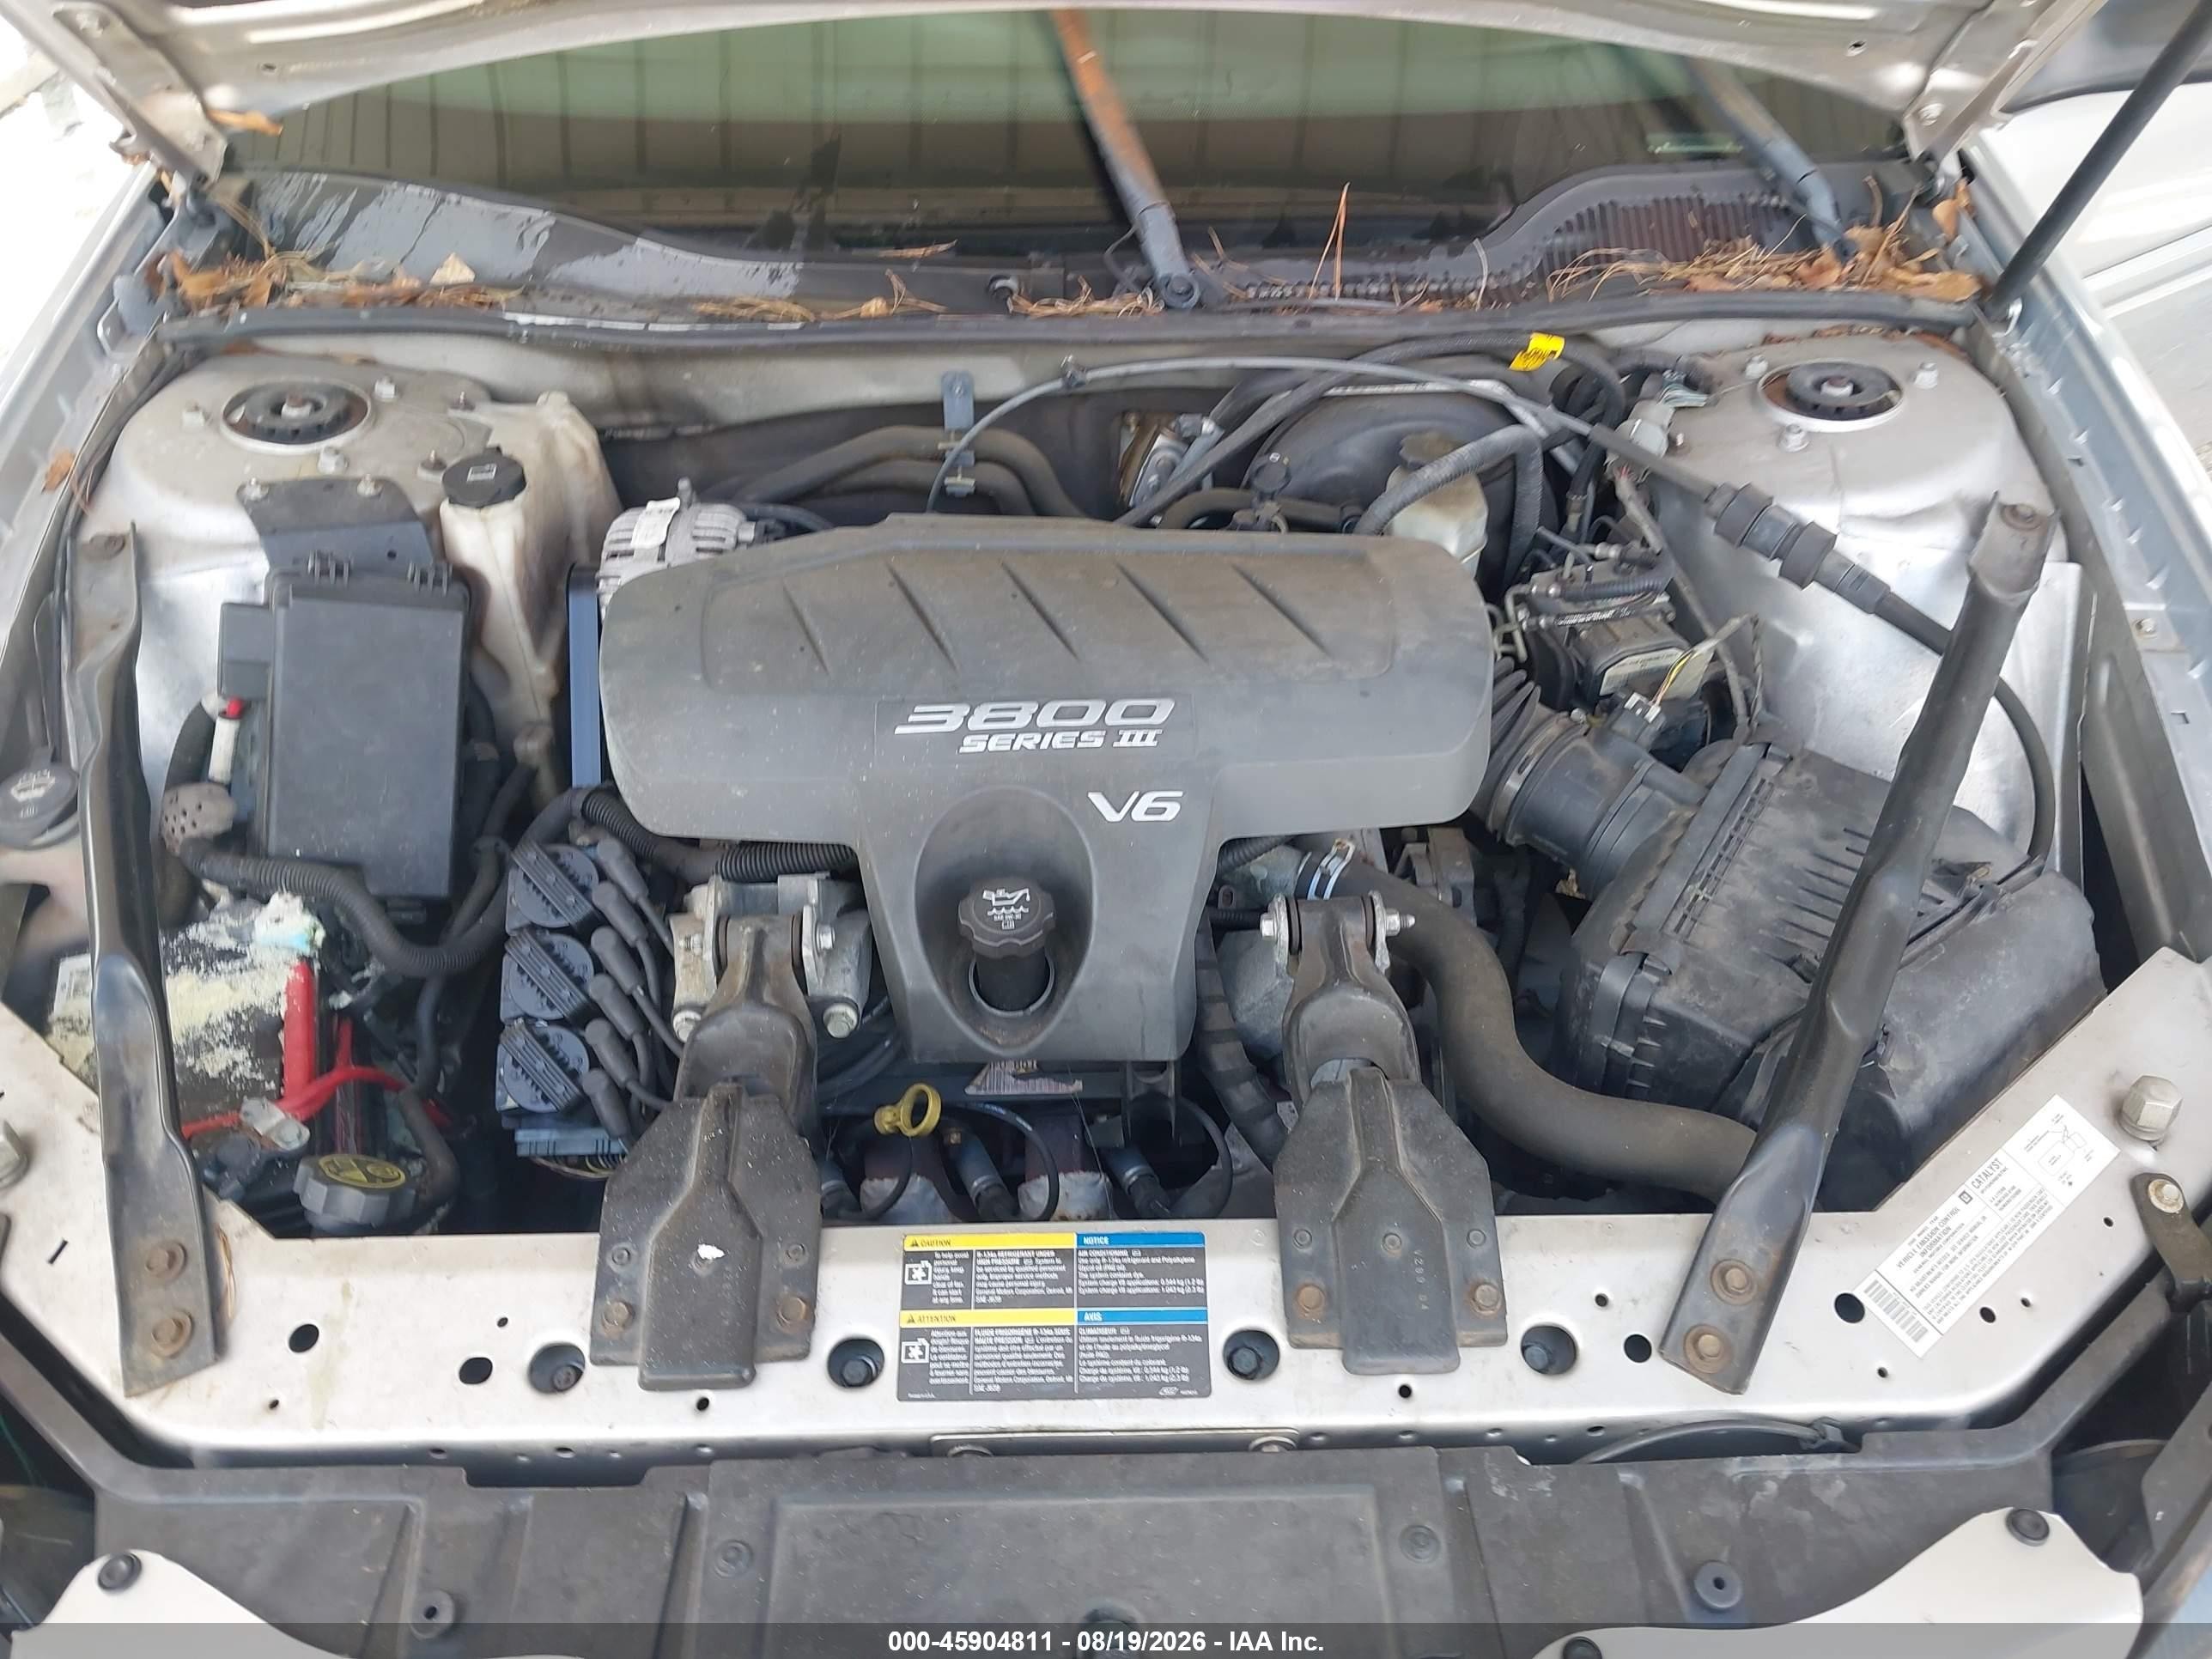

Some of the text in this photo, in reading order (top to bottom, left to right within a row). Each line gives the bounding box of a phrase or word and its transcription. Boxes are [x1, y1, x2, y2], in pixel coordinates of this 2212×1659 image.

[894, 698, 1175, 735] 3800
[958, 729, 1163, 753] SERIES III
[1087, 790, 1183, 823] V6
[1970, 1158, 2003, 1189] CATALYST
[1895, 1247, 1917, 1269] VEHICLE
[1915, 1225, 1941, 1249] EMISSION
[1937, 1206, 1960, 1228] CONTROL
[1918, 1224, 1952, 1258] INFORMATION
[1084, 1312, 1103, 1321] AVIS
